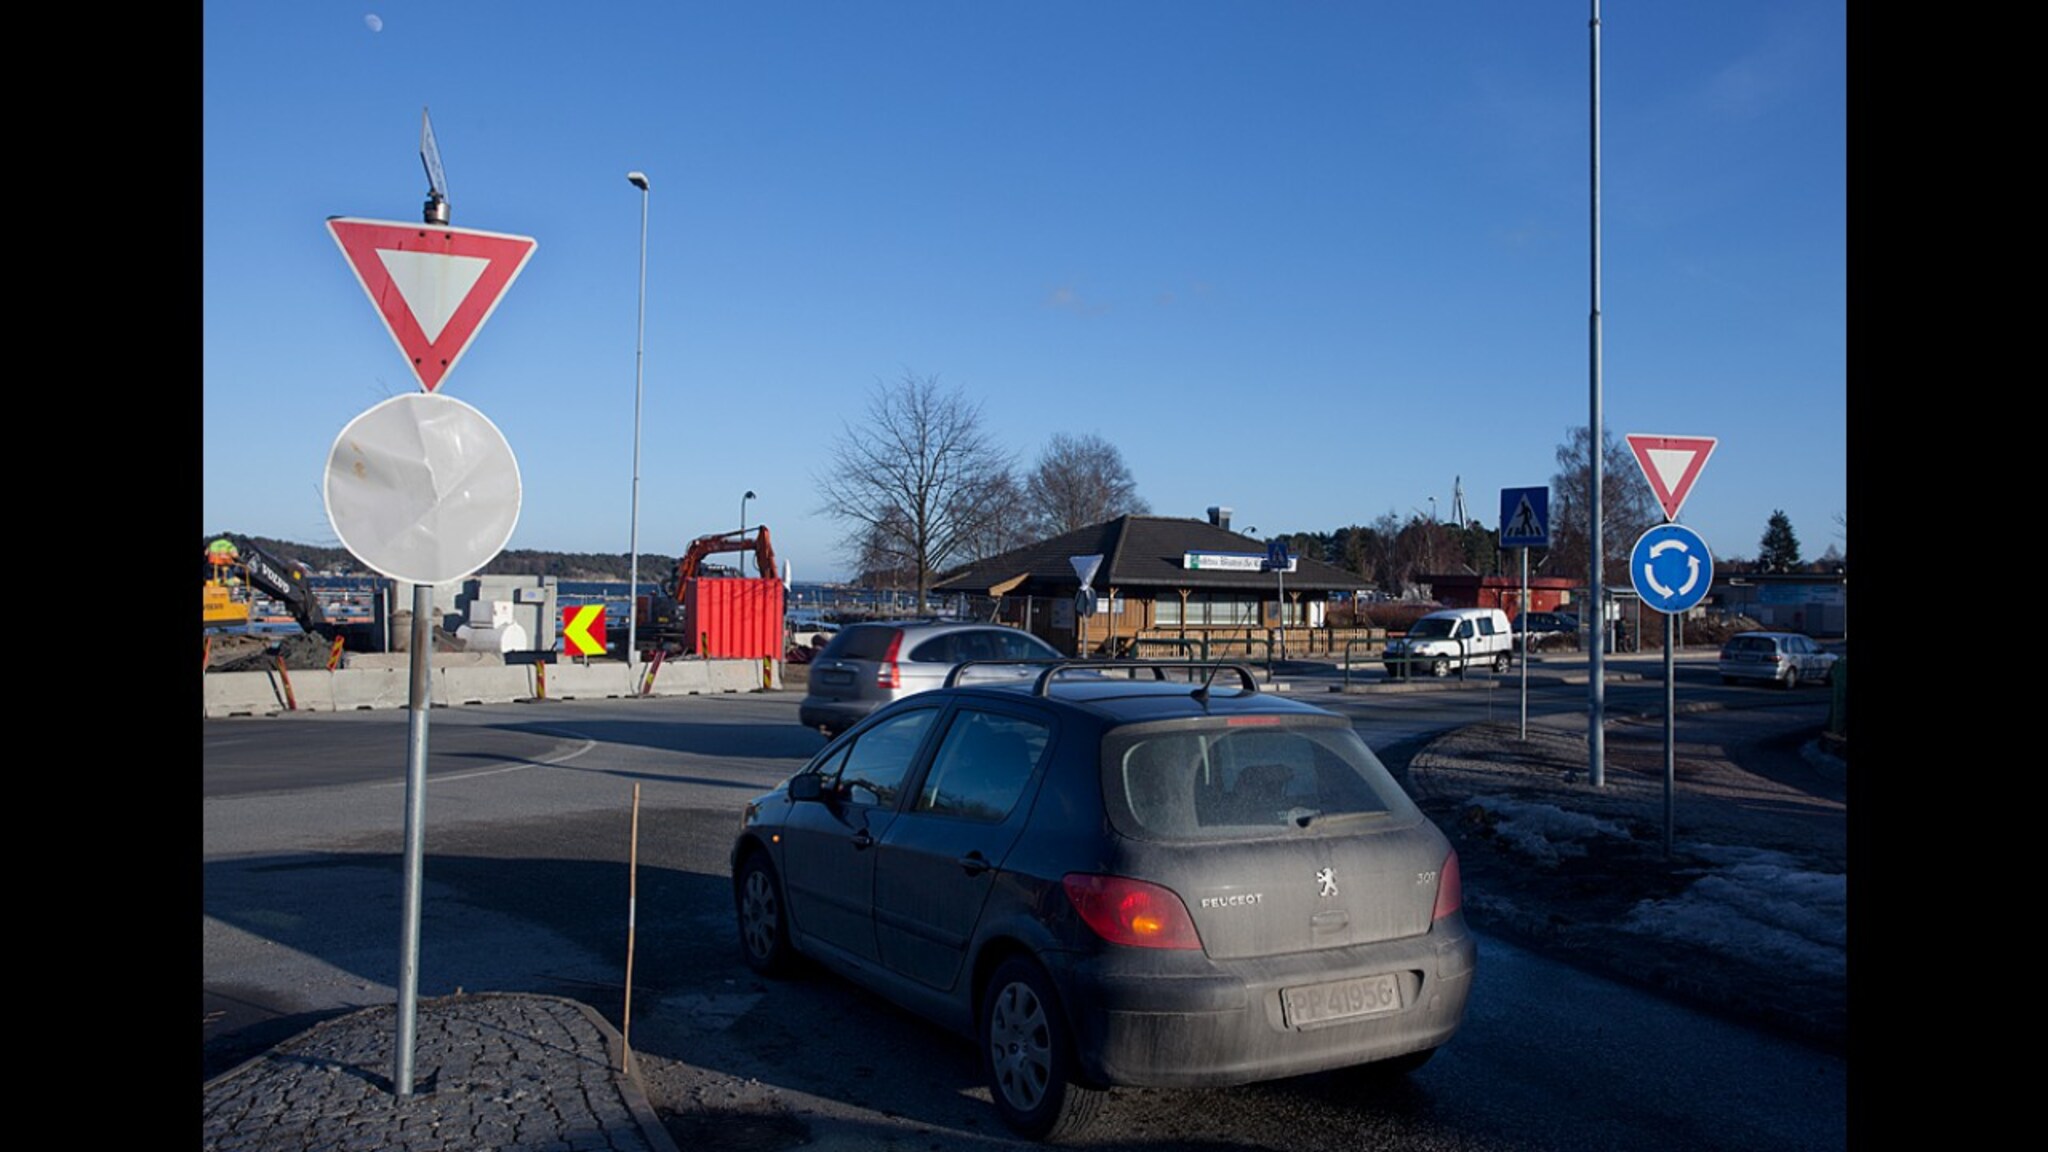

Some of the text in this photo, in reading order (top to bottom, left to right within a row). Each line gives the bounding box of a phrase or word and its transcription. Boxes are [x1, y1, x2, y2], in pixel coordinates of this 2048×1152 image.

[262, 563, 290, 593] VOLVO
[1416, 871, 1436, 885] 307
[1201, 893, 1263, 908] PEUGEOT
[1327, 977, 1392, 1014] 41956
